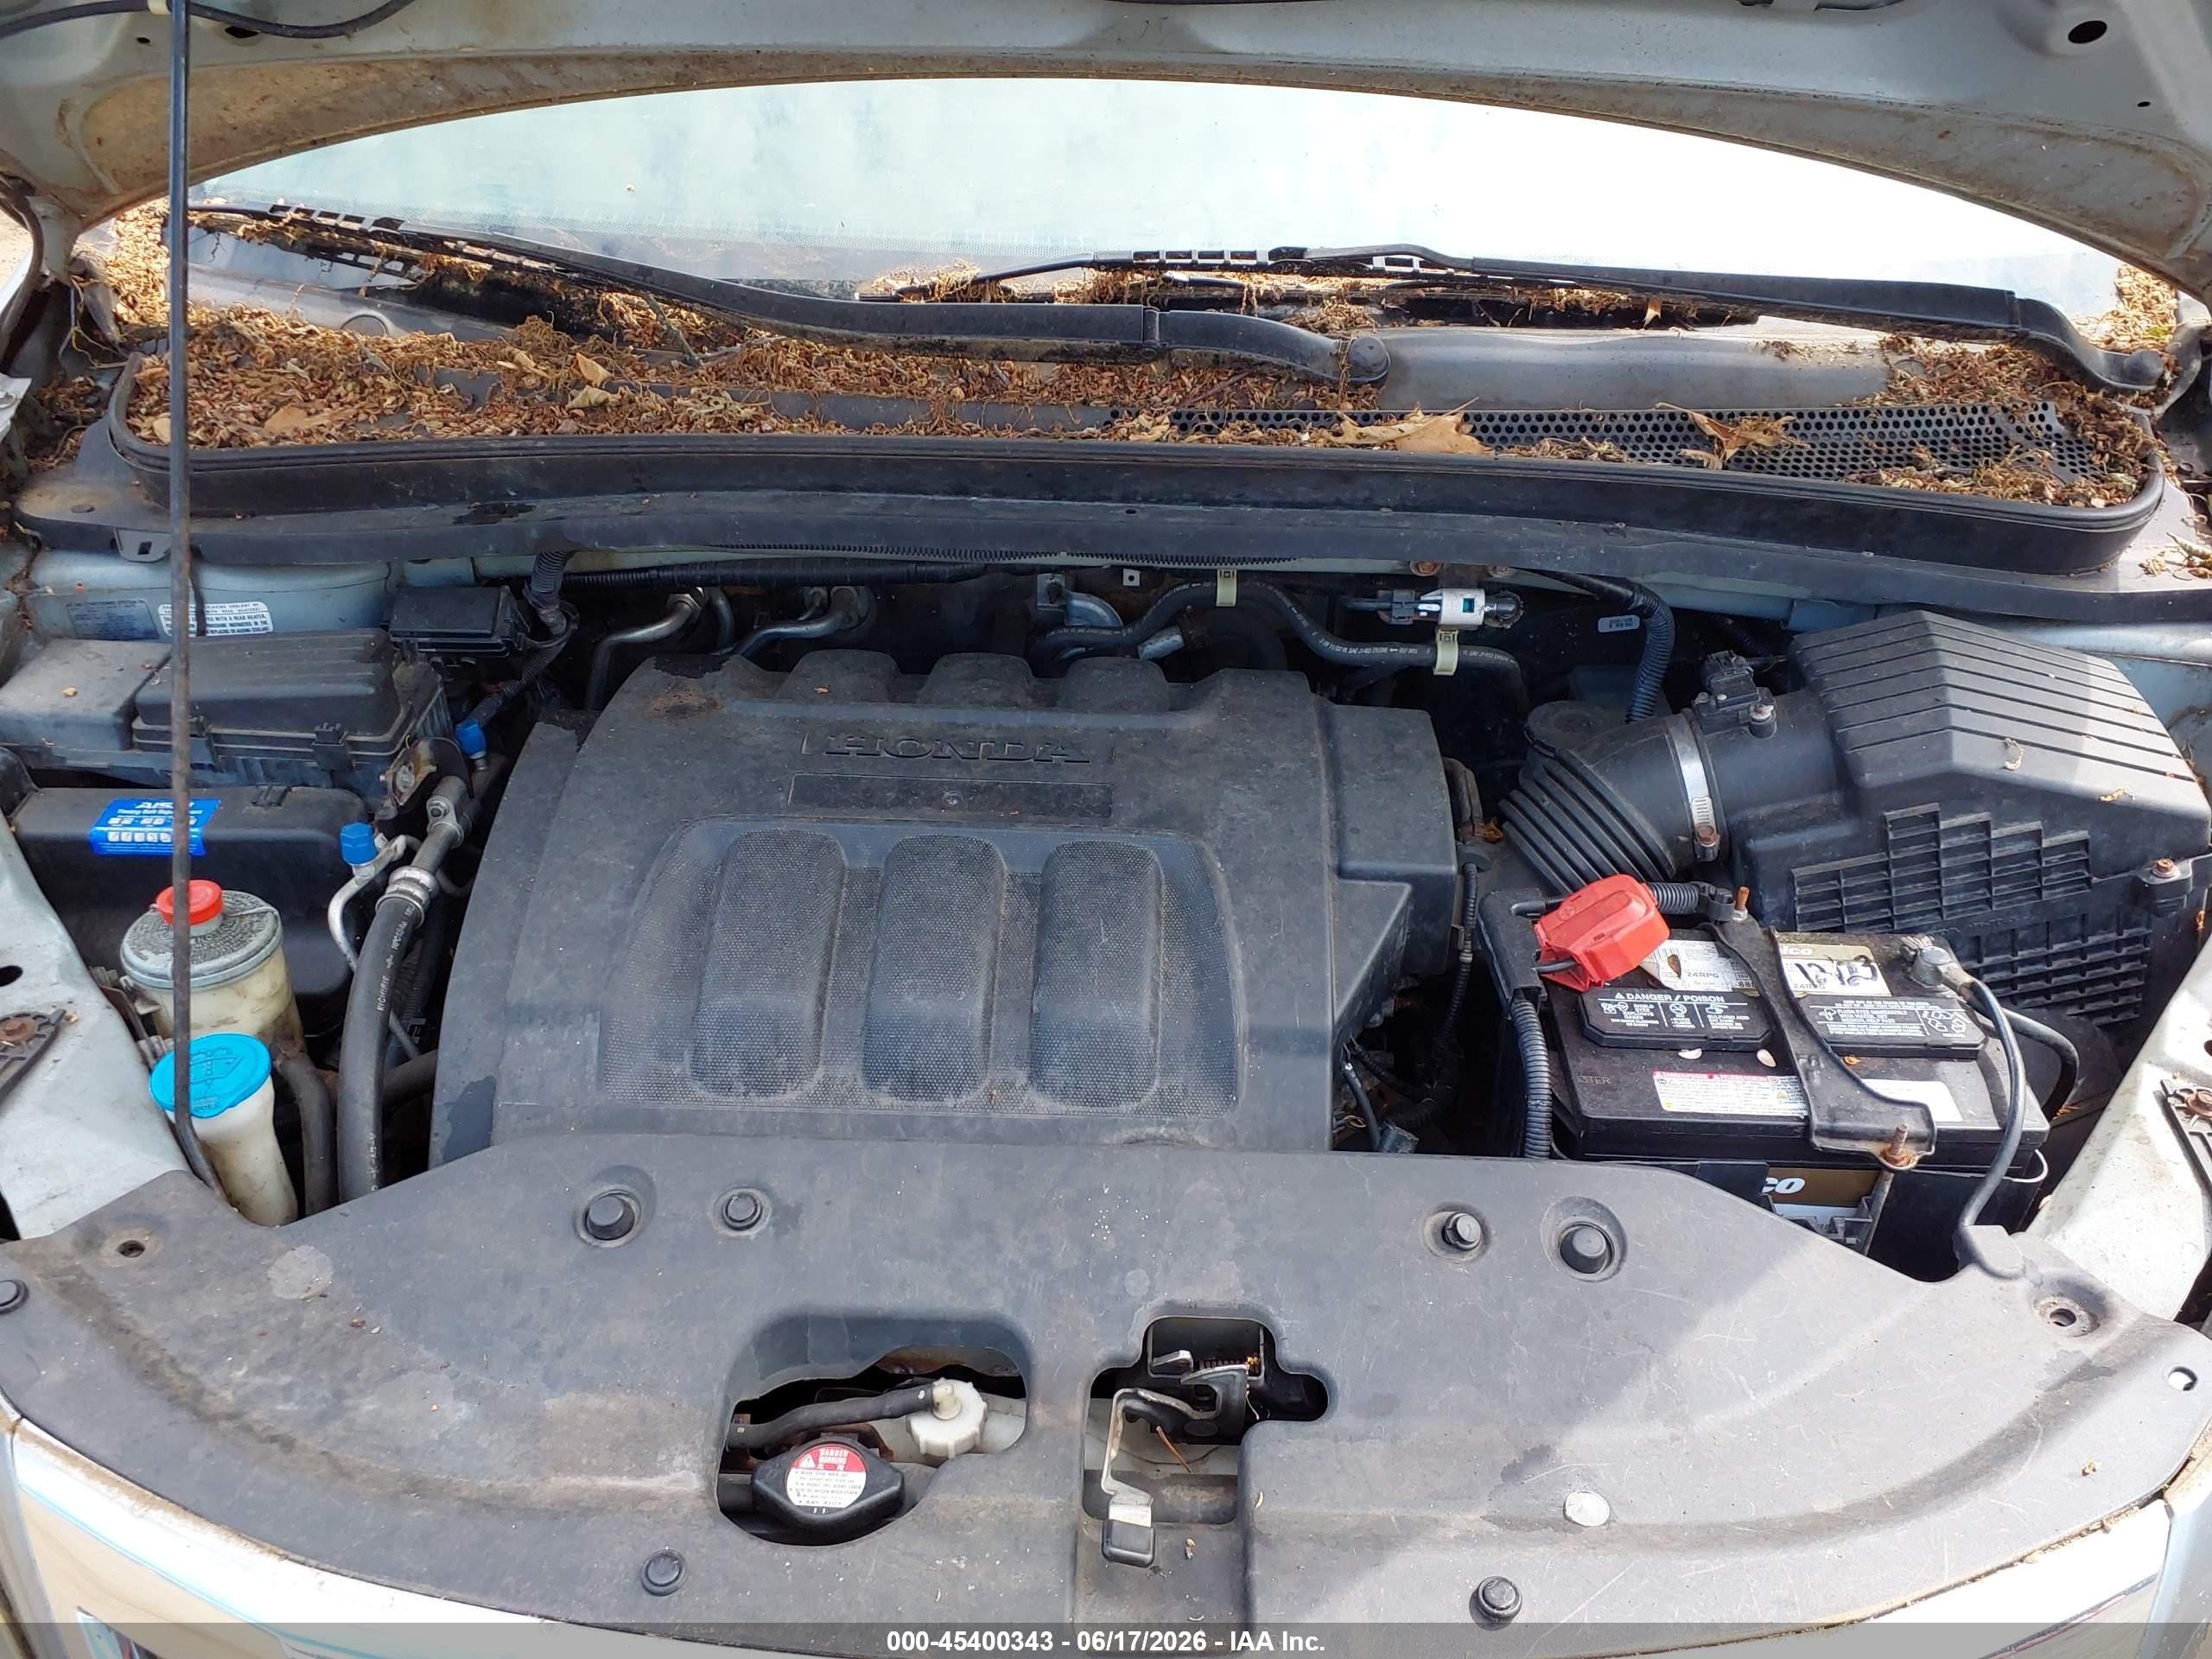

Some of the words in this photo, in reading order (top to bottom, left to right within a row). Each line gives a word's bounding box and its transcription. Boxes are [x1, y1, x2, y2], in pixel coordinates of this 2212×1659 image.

[824, 735, 1091, 764] HONDA
[1626, 992, 1673, 1001] DANGER
[819, 1448, 849, 1457] DANGER
